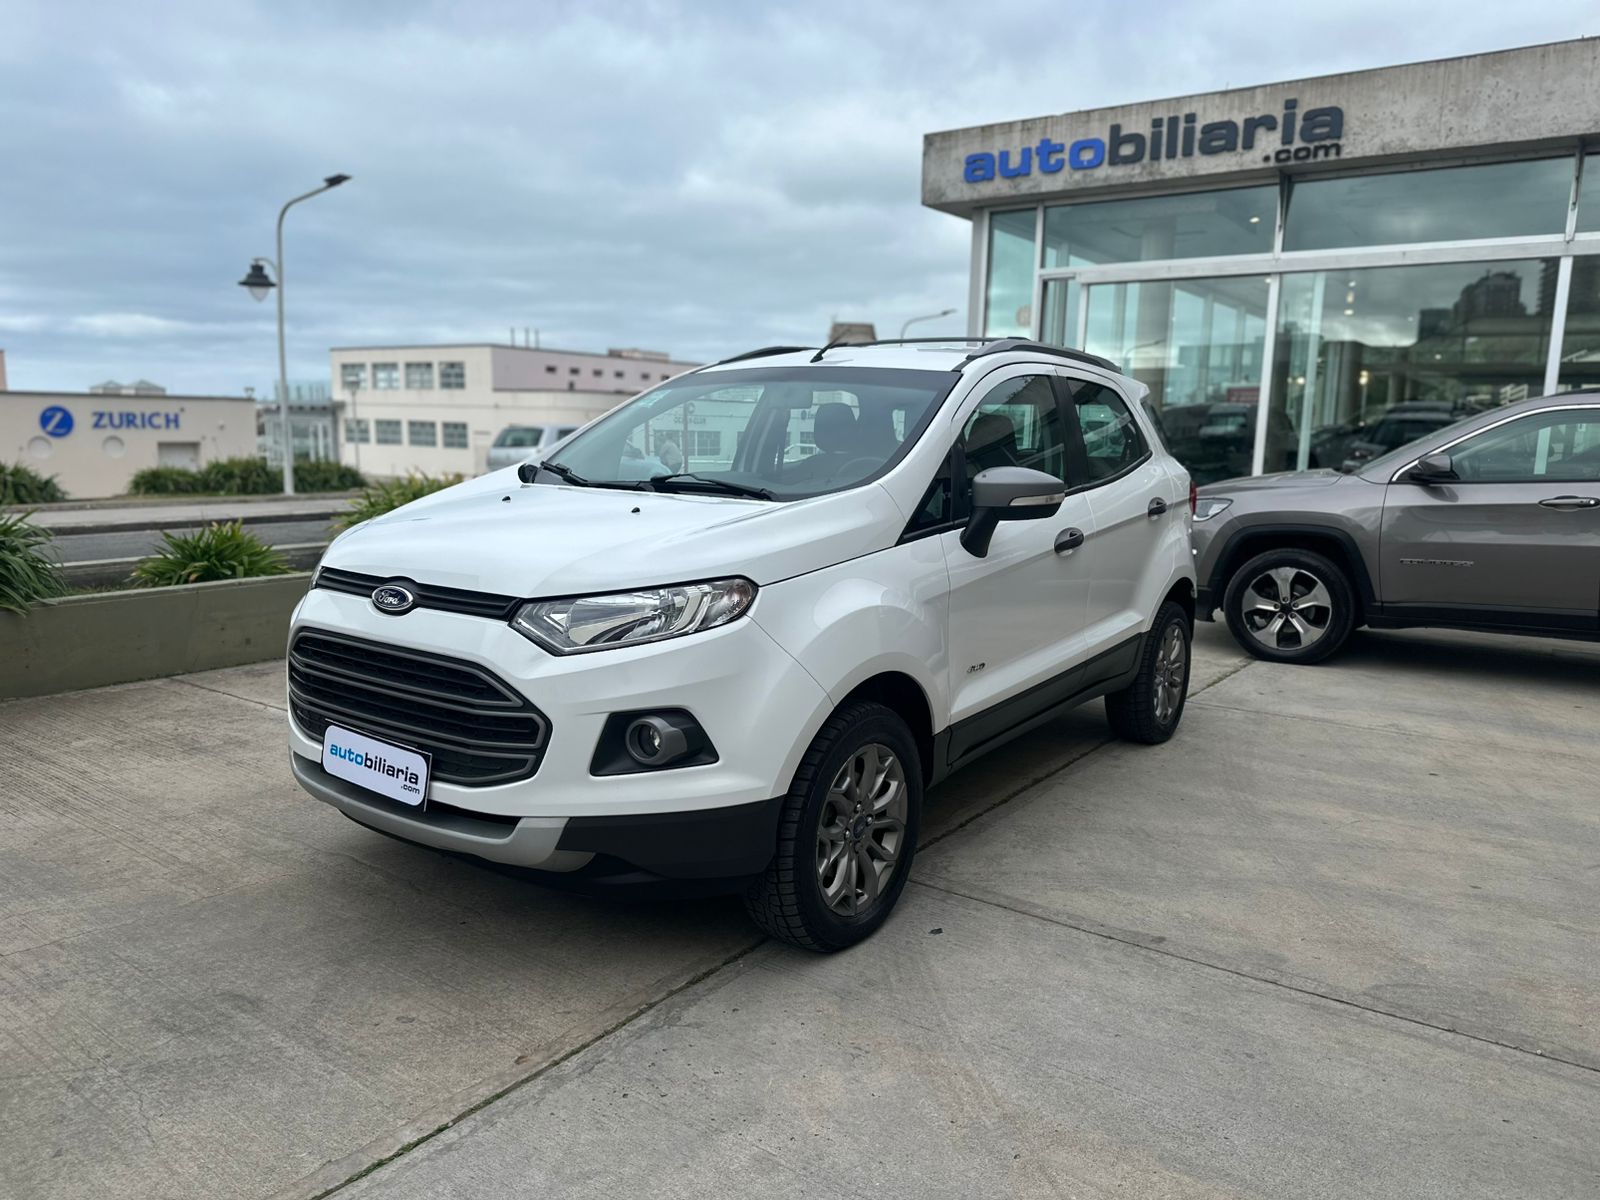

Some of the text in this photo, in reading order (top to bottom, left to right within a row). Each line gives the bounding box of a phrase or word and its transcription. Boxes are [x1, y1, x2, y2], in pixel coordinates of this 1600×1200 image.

[963, 98, 1344, 183] autobiliaria
[1262, 142, 1342, 164] .com
[92, 411, 180, 430] ZURICH
[330, 744, 419, 786] autobiliaria
[401, 783, 420, 795] .com
